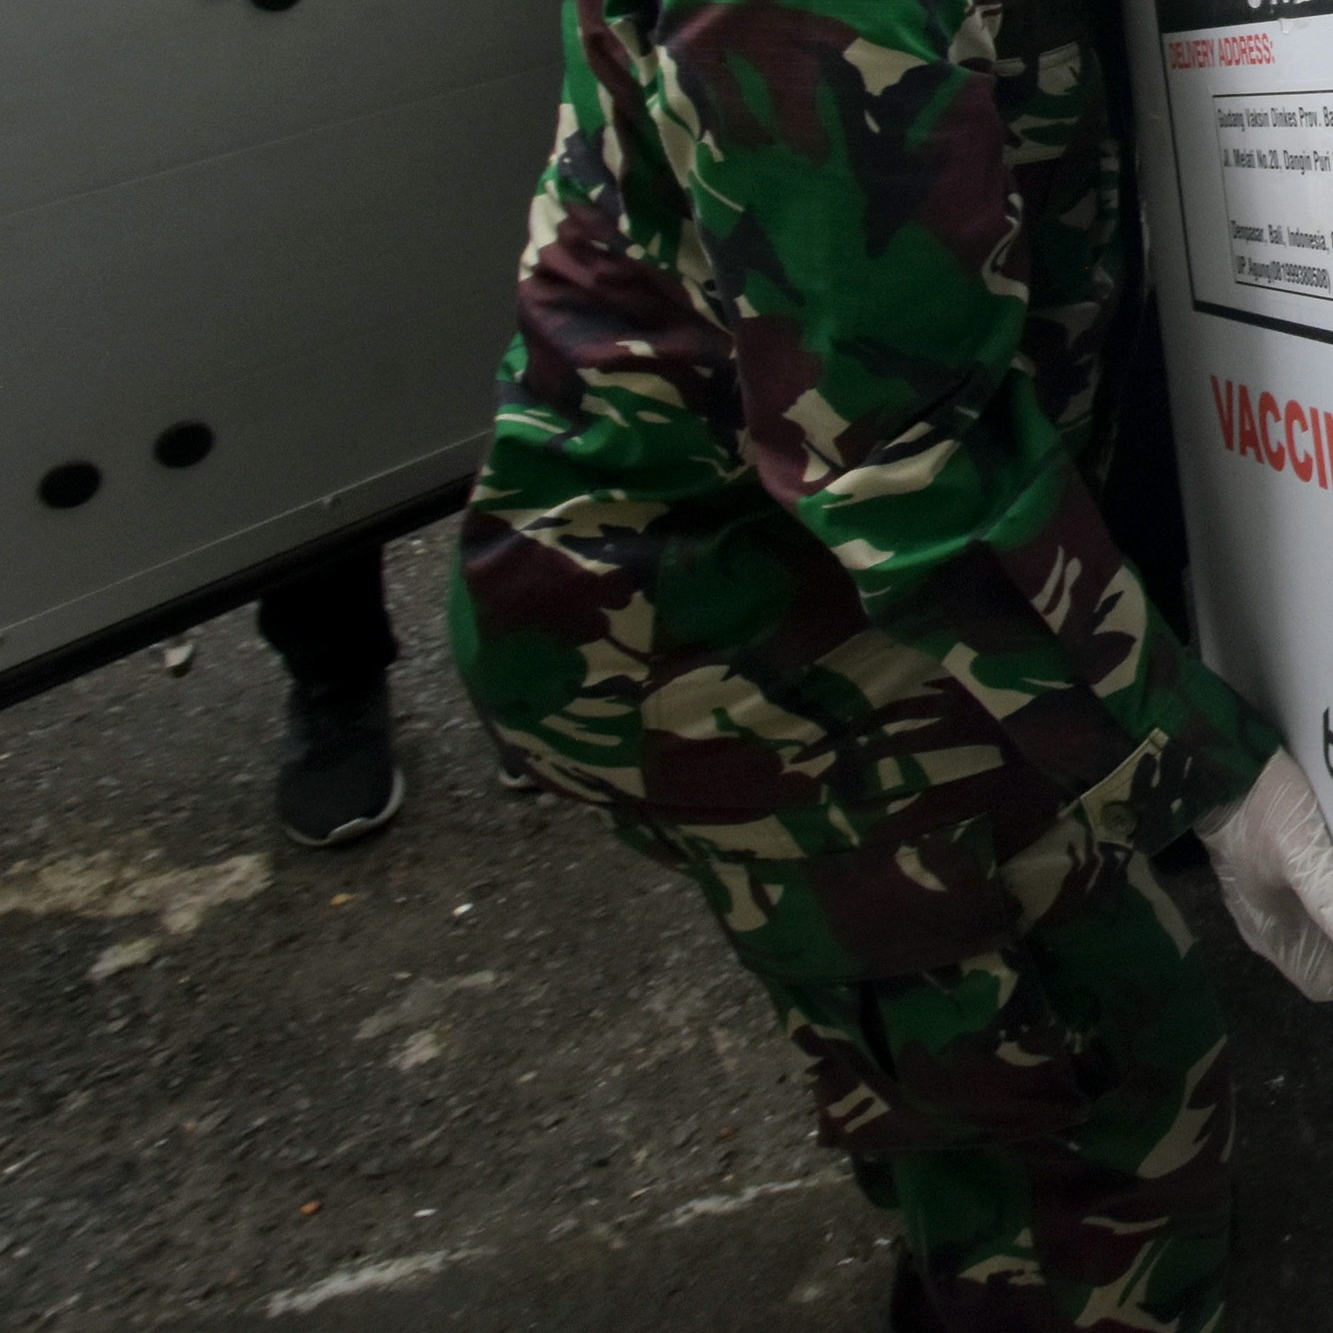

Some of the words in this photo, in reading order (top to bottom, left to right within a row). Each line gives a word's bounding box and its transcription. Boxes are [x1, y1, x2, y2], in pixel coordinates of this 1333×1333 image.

[1169, 39, 1215, 70] DELIVERY
[1218, 33, 1276, 66] ADDRESS:
[1299, 106, 1322, 127] Prov.
